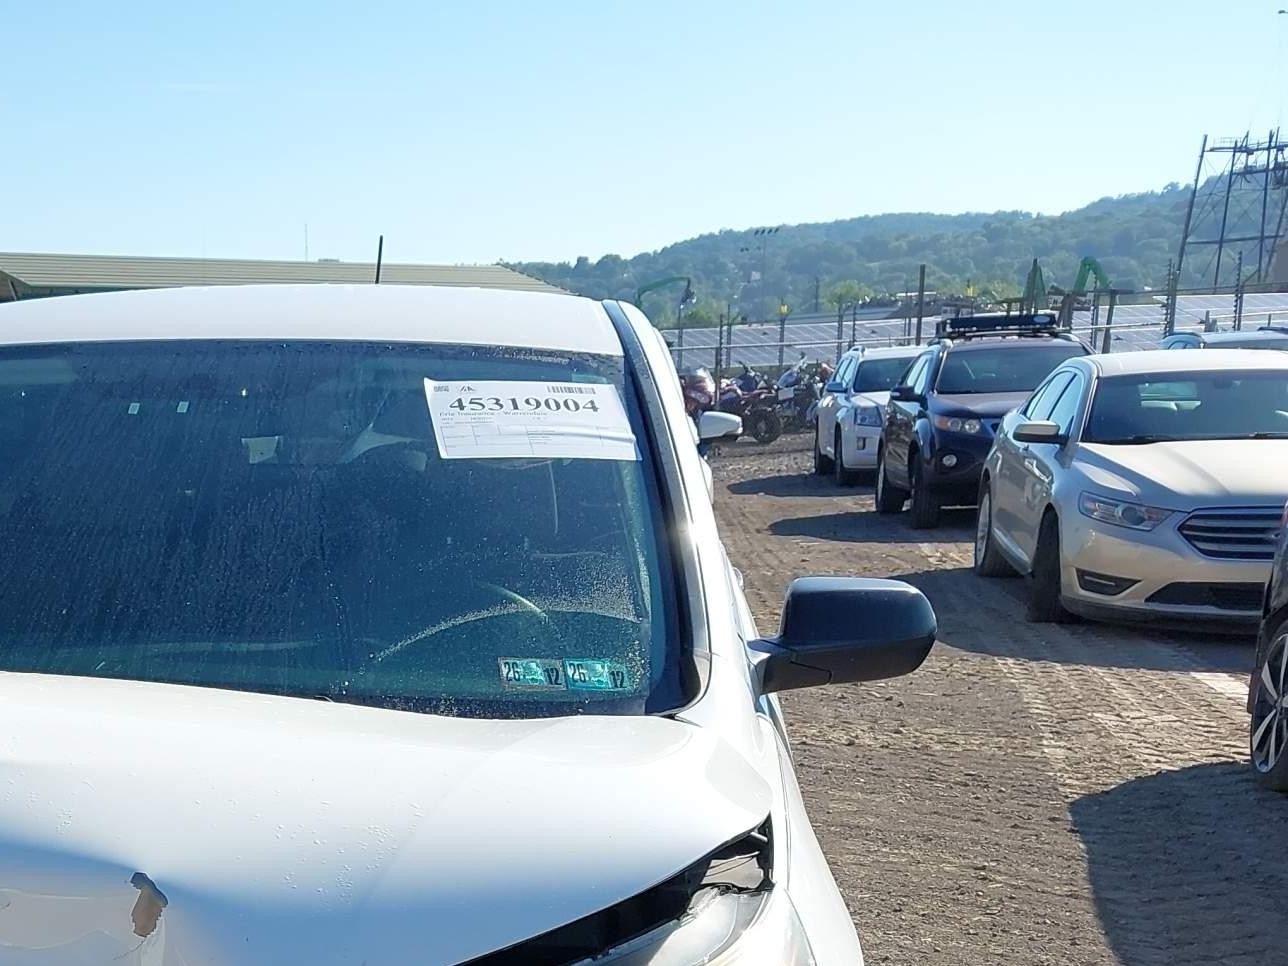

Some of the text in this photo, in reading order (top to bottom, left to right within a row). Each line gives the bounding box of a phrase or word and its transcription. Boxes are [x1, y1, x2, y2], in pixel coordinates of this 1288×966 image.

[449, 397, 599, 412] 45319004
[503, 661, 521, 681] 26
[569, 663, 587, 684] 26
